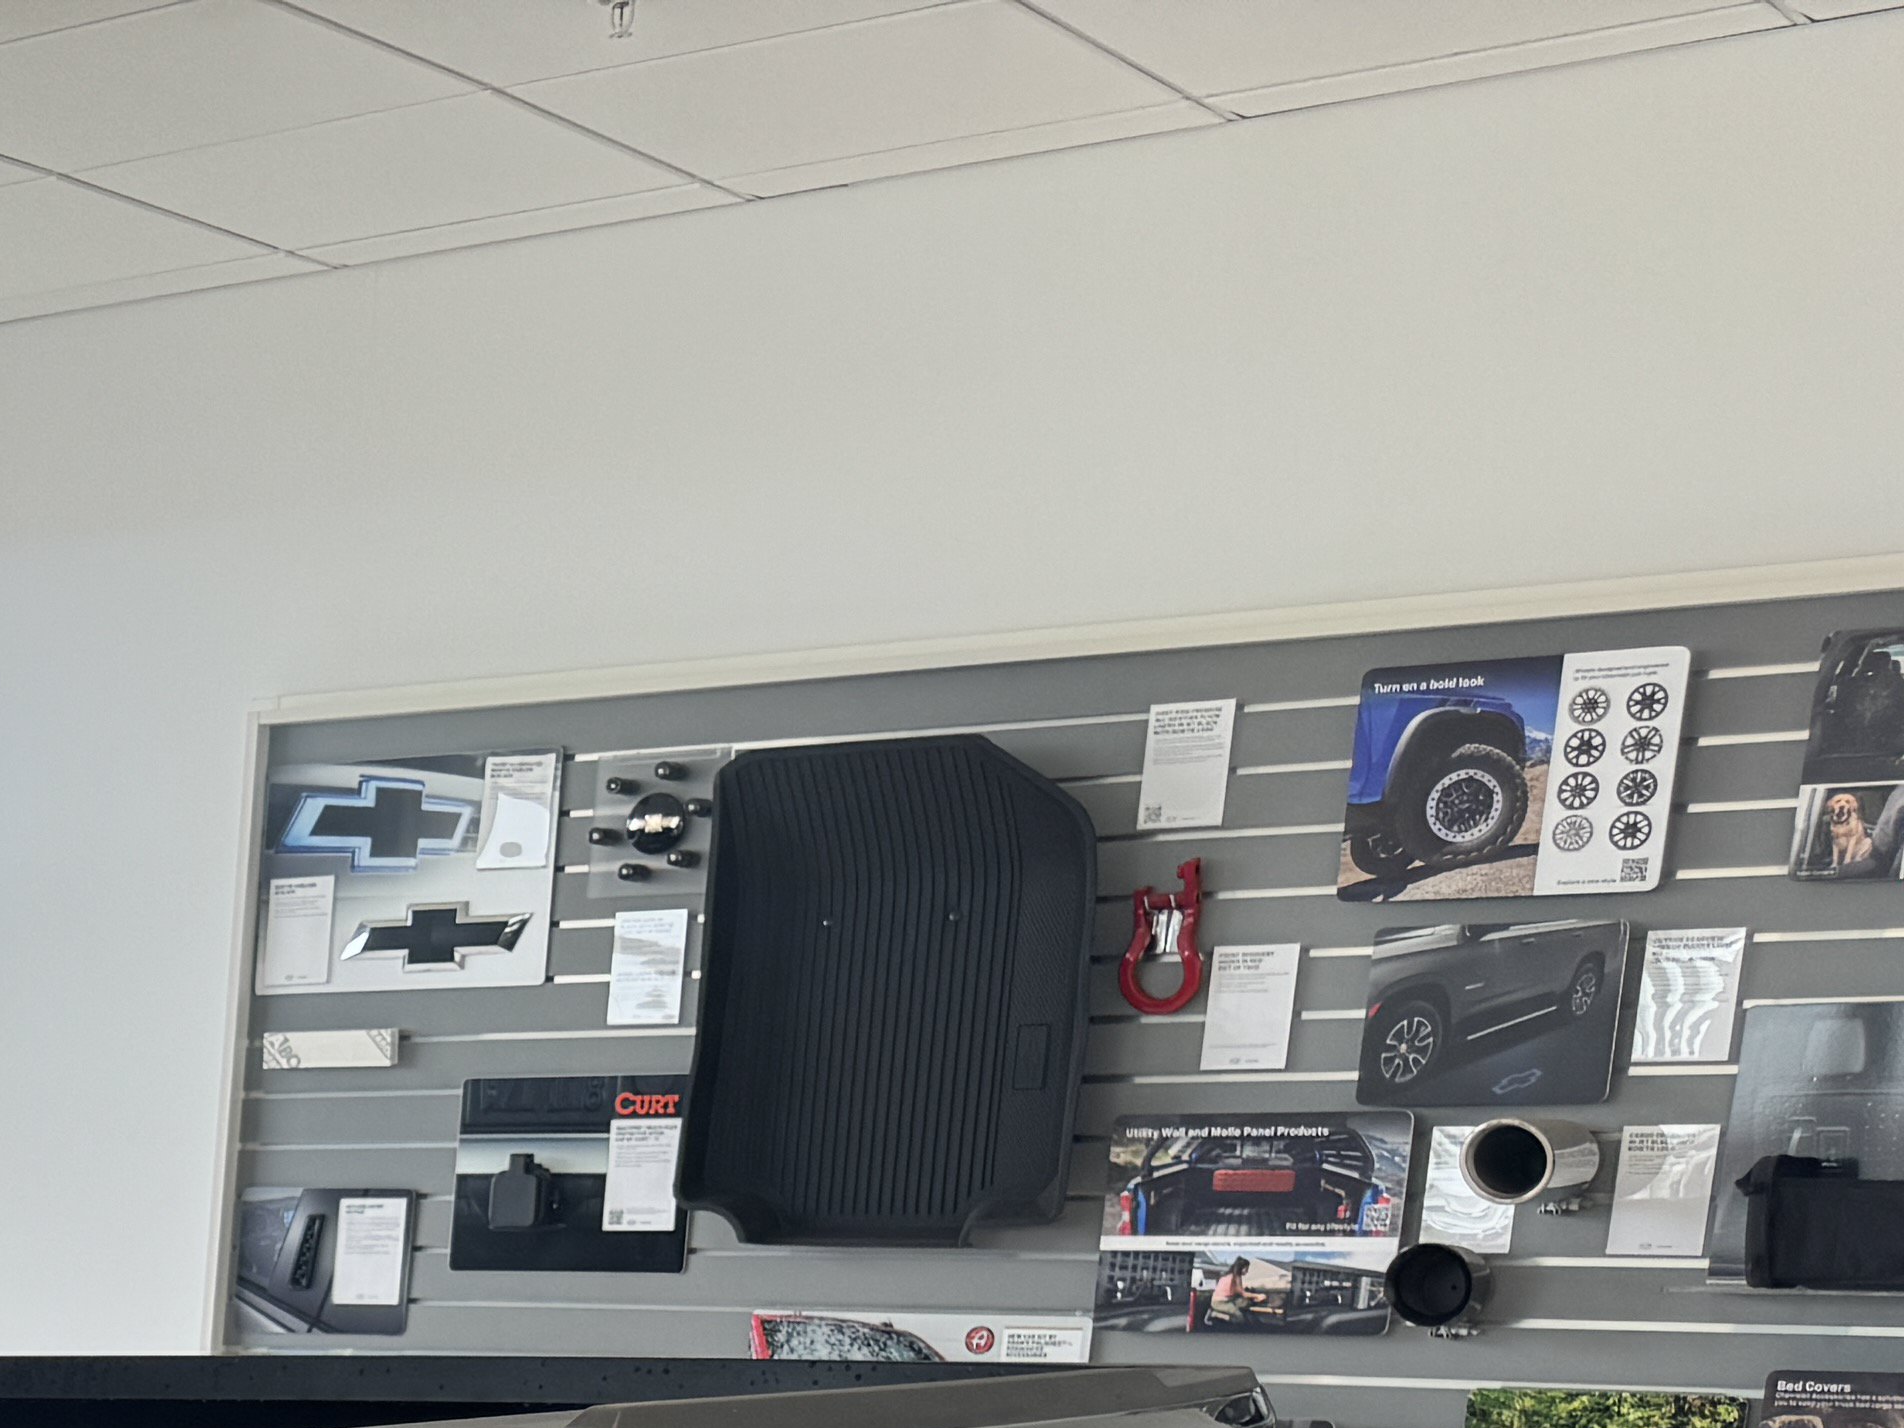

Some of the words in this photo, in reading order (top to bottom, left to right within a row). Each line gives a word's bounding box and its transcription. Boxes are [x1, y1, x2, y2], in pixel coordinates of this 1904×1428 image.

[1374, 683, 1400, 694] Turn
[1402, 683, 1418, 693] on
[1419, 682, 1428, 690] a
[1429, 677, 1456, 690] bold
[1458, 676, 1485, 688] look
[615, 1091, 681, 1115] CURT
[1126, 1127, 1159, 1140] Utility
[1161, 1127, 1187, 1138] Wall
[1187, 1127, 1209, 1138] and
[1211, 1126, 1241, 1138] Molle
[1243, 1126, 1275, 1137] Panel
[1277, 1125, 1330, 1137] Products
[1777, 1380, 1803, 1391] Bed
[1805, 1381, 1852, 1393] Covers
